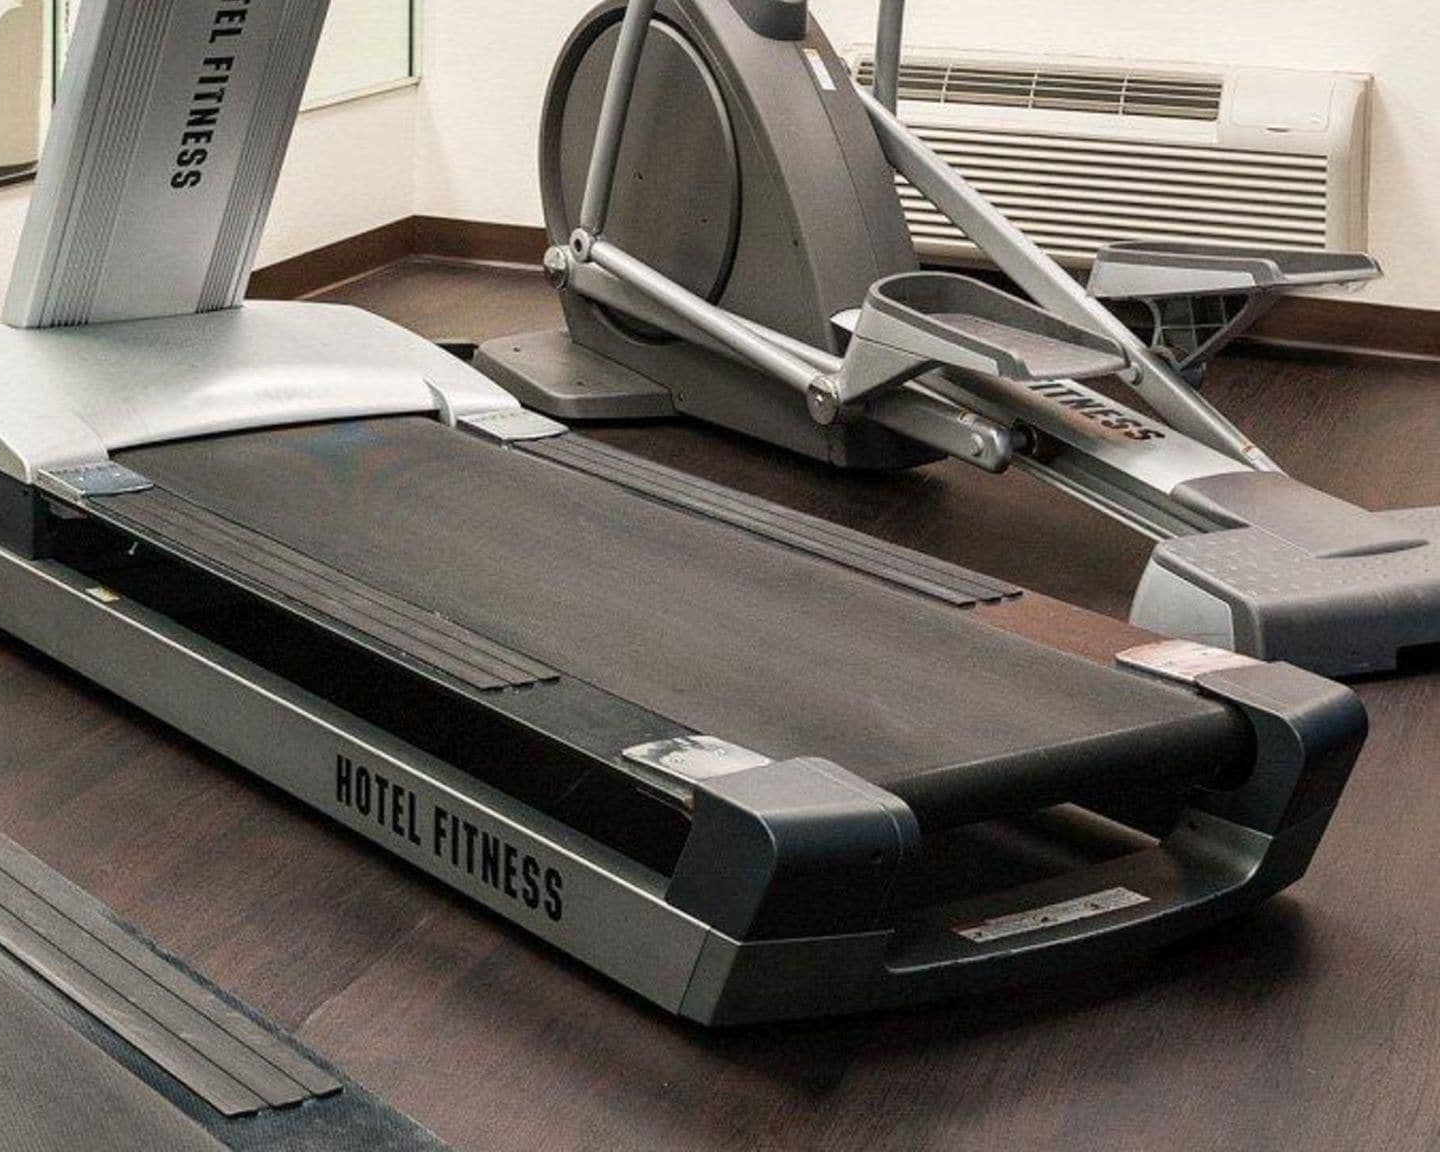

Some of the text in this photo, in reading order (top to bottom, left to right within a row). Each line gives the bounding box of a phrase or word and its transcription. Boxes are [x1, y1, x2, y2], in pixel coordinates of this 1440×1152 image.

[170, 56, 235, 189] FITNESS
[1026, 382, 1166, 441] ITNESS
[336, 753, 563, 923] HOTEL FITNESS
